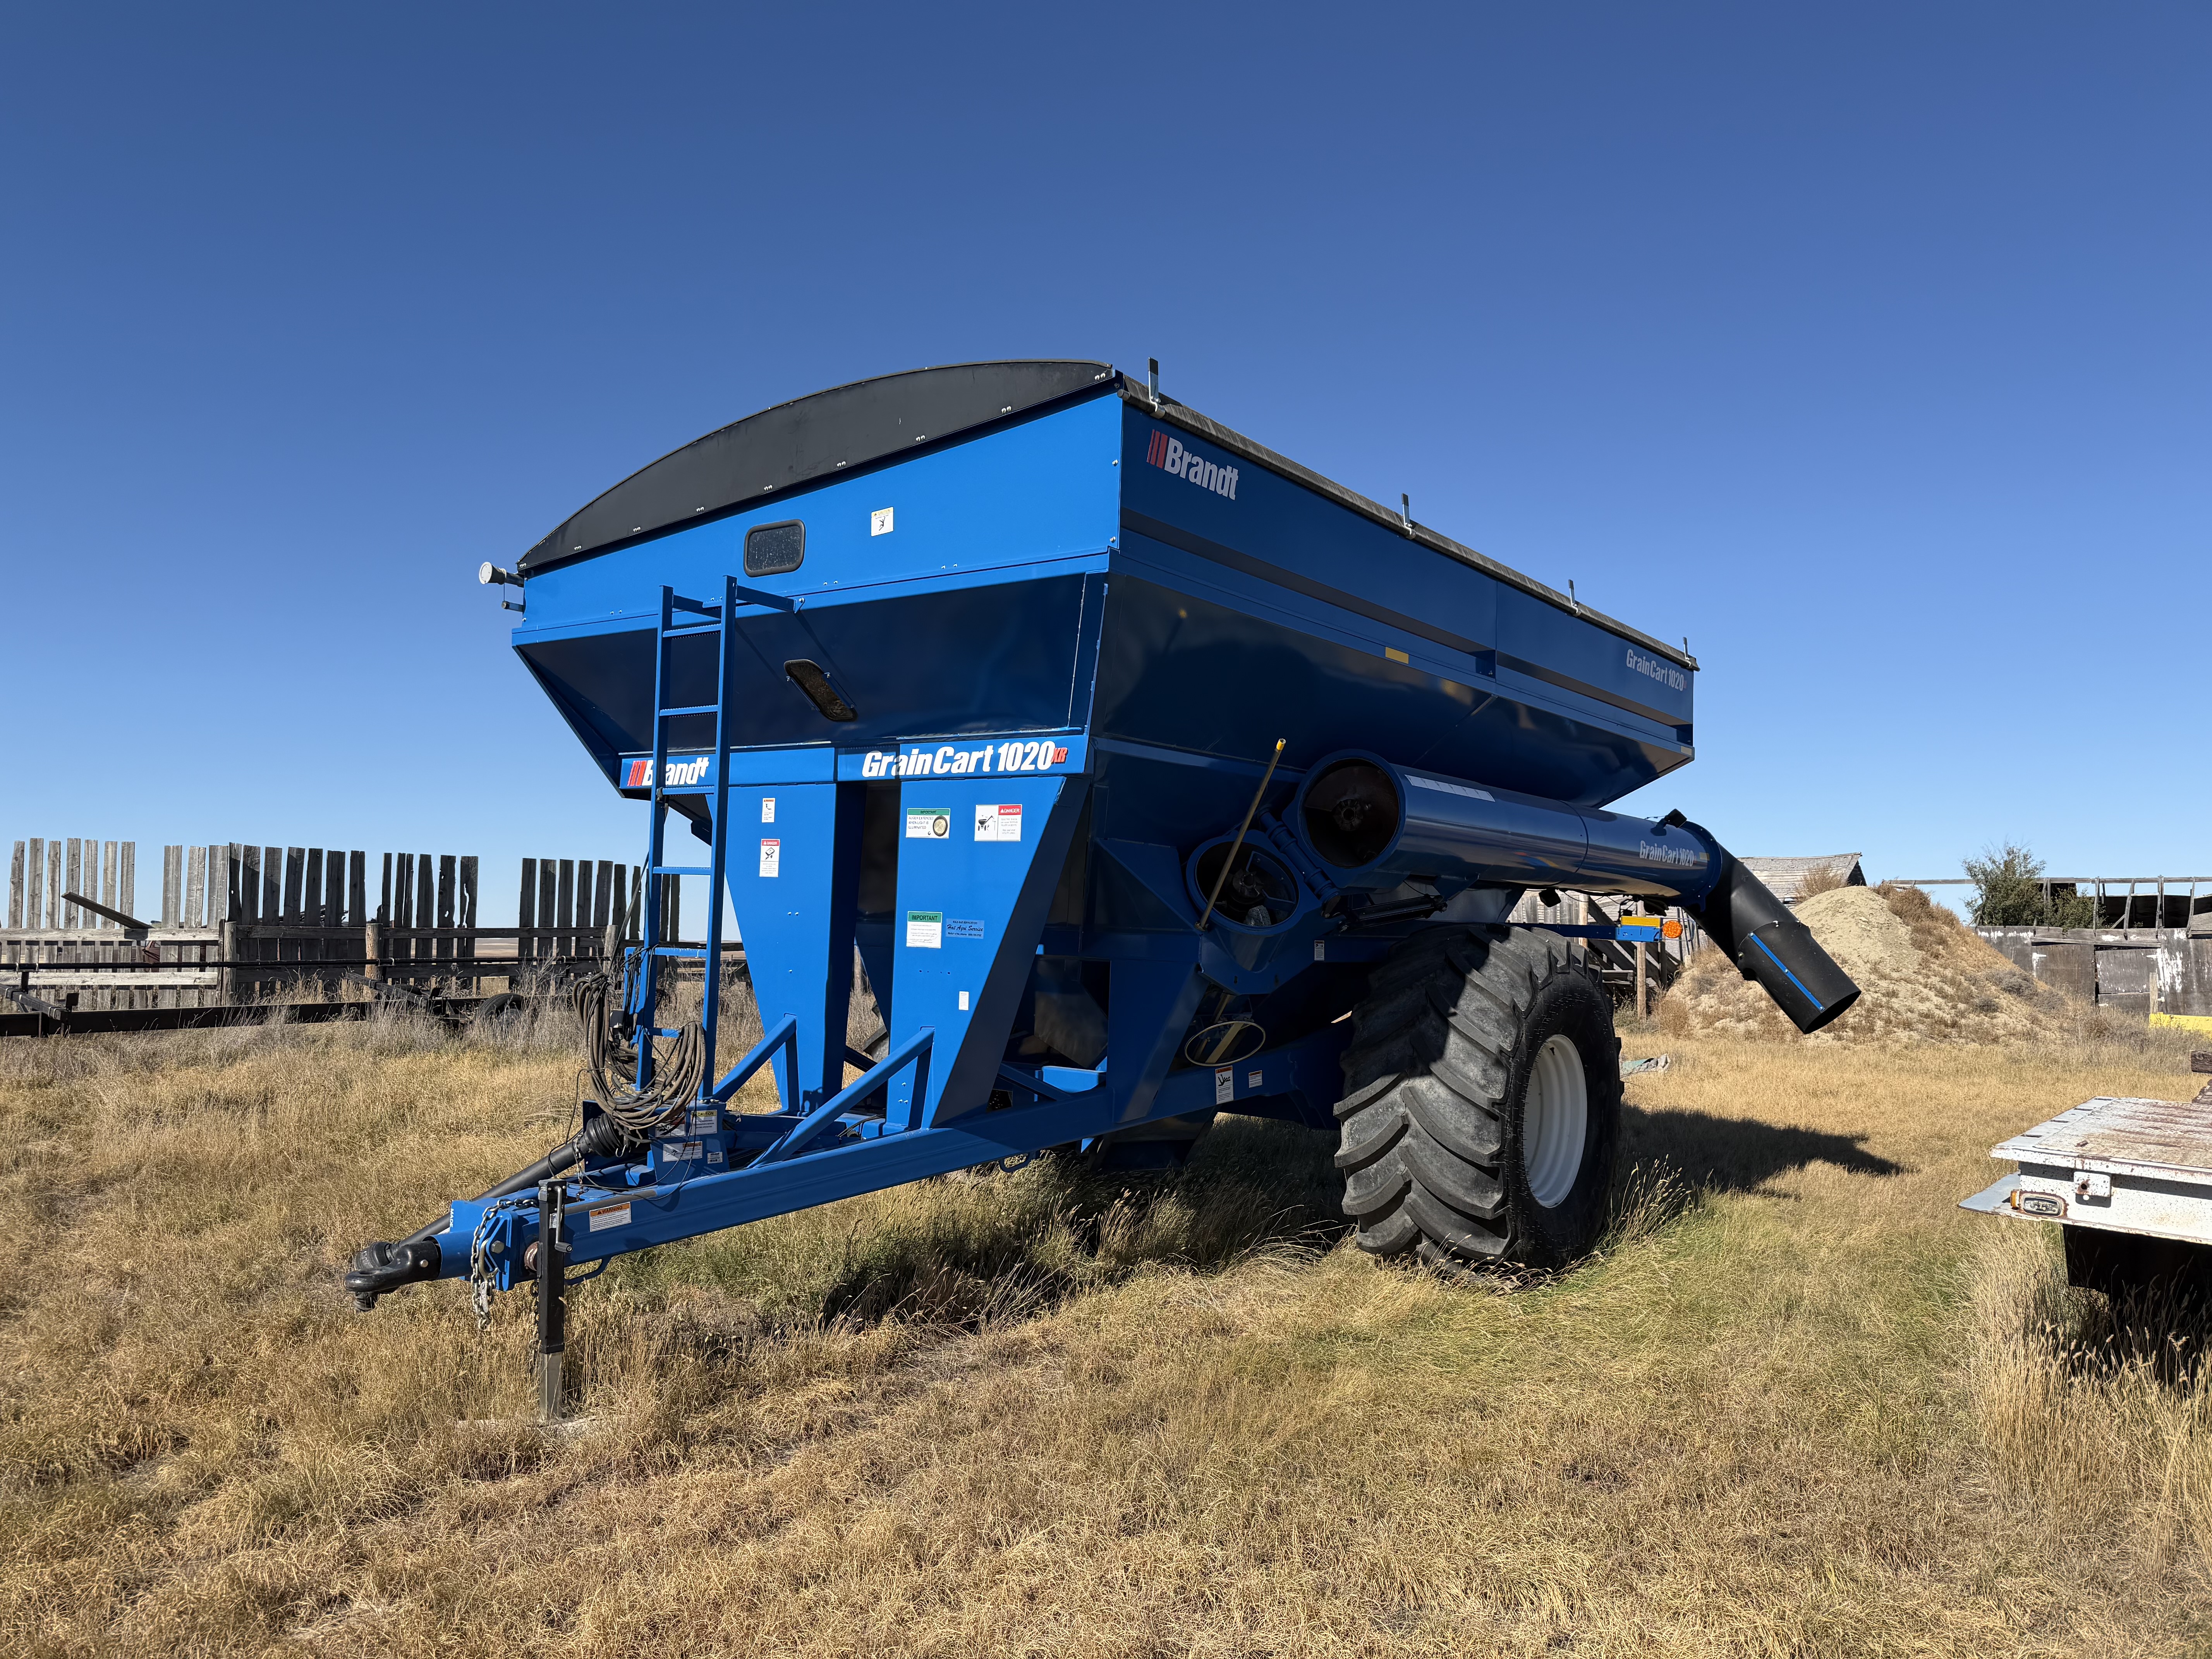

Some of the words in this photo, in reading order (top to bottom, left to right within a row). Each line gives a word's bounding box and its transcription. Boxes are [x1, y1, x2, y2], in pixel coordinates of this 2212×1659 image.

[1164, 437, 1238, 500] Brandt
[1626, 649, 1668, 684] GrainCart
[1668, 668, 1684, 691] 1020
[641, 757, 709, 786] Bandt
[862, 745, 994, 778] GrainCart
[998, 740, 1056, 771] 1020
[1051, 747, 1068, 764] XR
[1679, 847, 1693, 867] 1020
